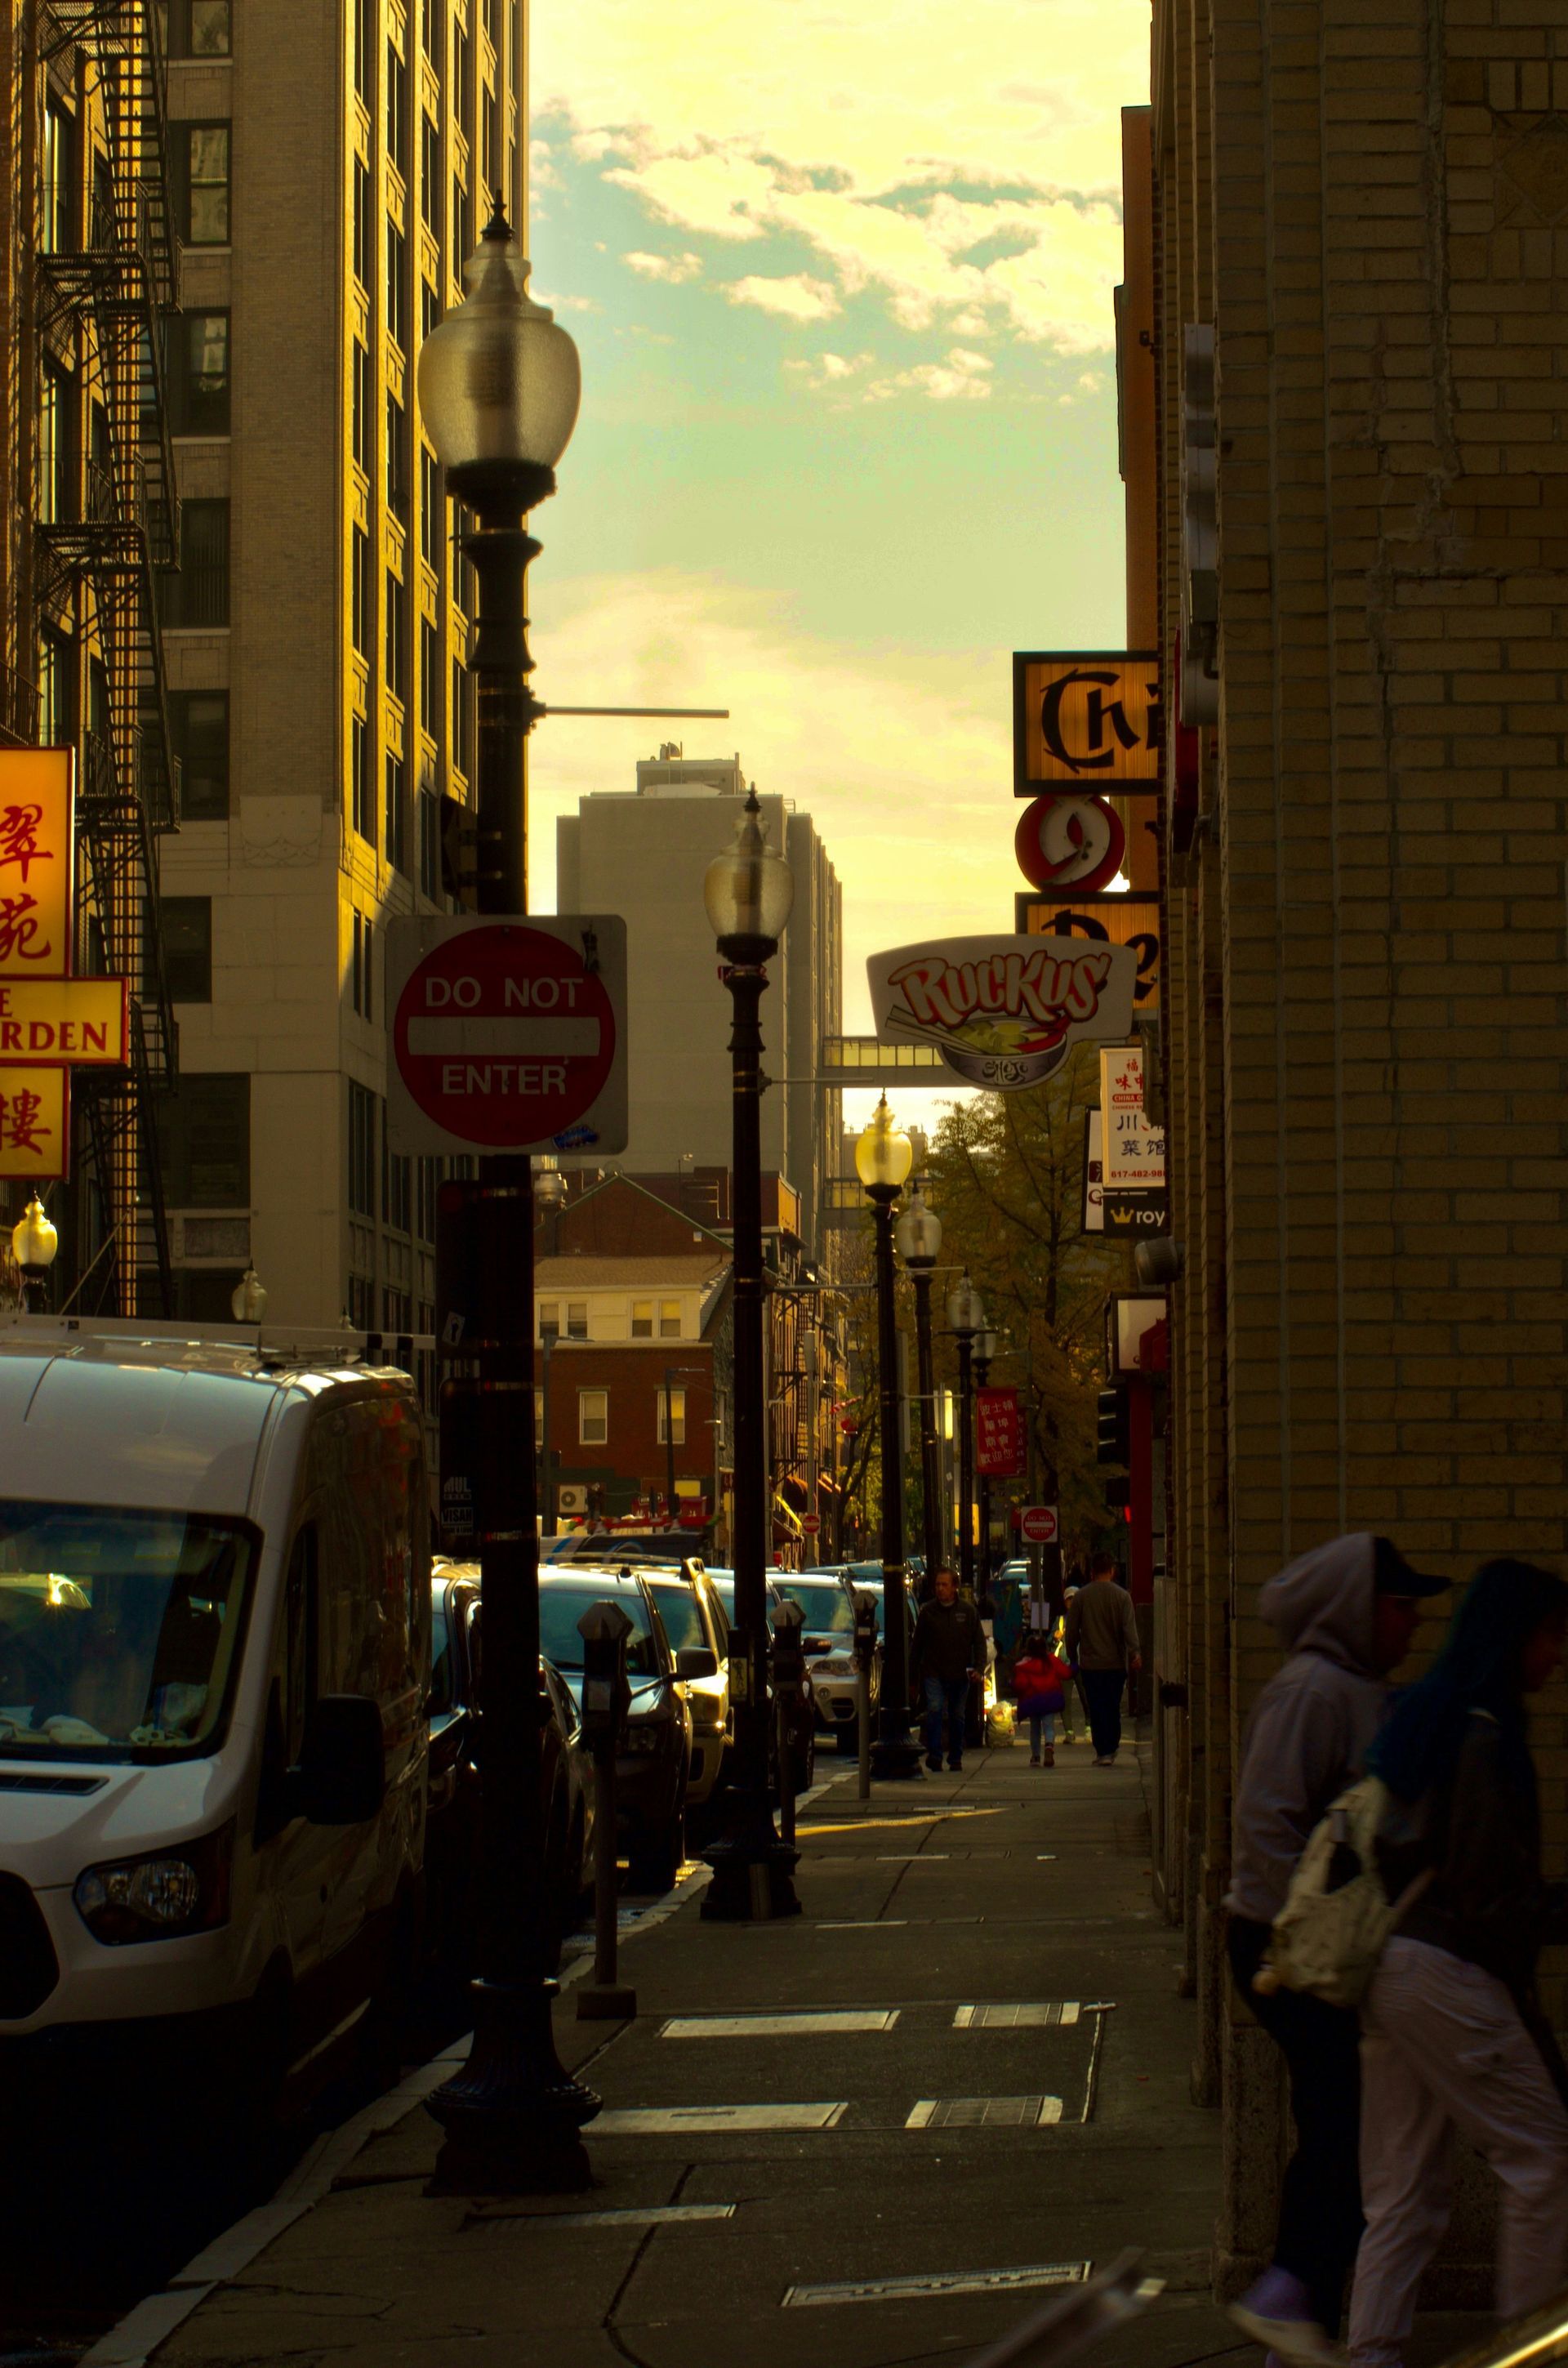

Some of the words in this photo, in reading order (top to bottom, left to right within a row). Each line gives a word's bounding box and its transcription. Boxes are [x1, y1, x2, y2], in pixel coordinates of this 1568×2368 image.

[425, 976, 482, 1009] DO
[504, 976, 585, 1009] NOT
[888, 950, 1112, 1028] RUCKUS
[1, 1021, 108, 1051] RDEN
[442, 1064, 567, 1095] ENTER
[1136, 1210, 1165, 1228] roy
